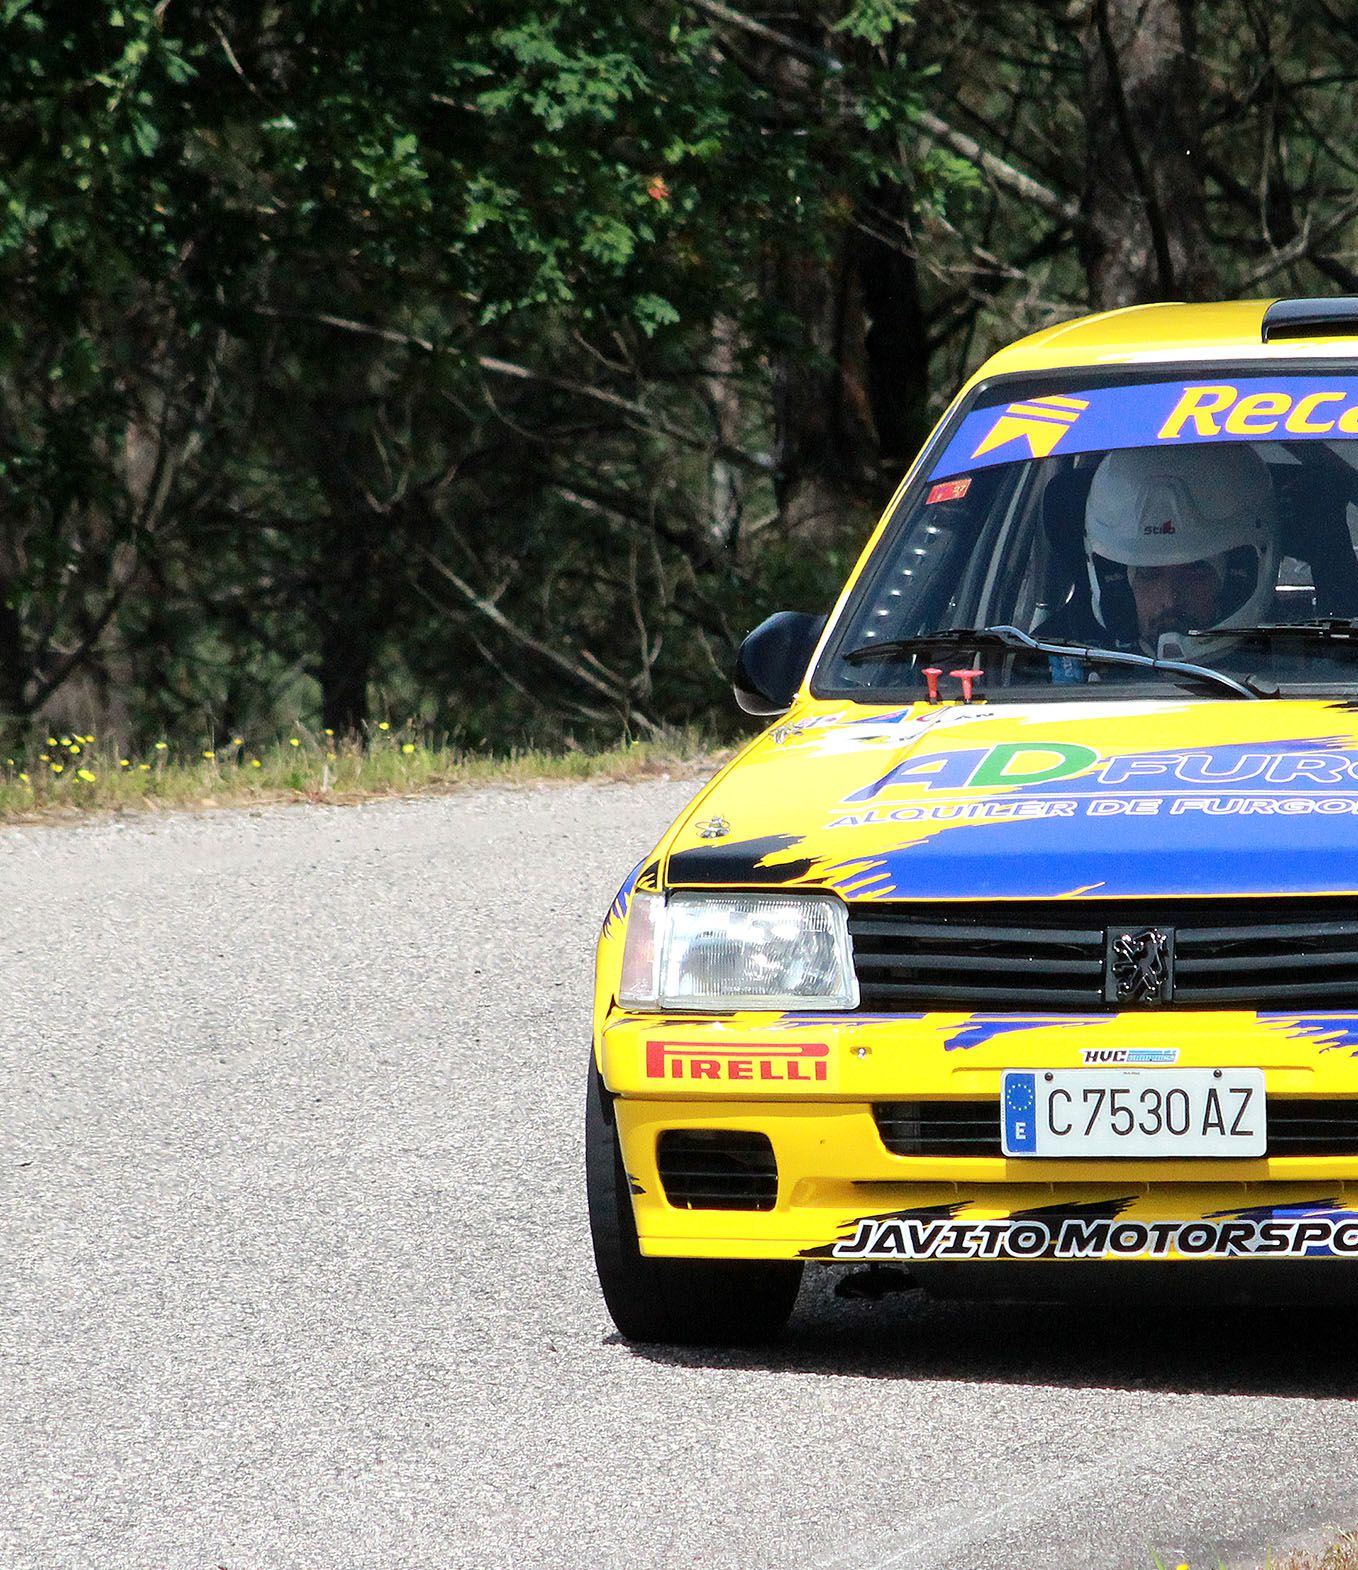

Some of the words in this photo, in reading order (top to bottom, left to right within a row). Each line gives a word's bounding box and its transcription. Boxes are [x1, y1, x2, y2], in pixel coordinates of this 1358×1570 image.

[824, 799, 1076, 829] ALQUILER
[1086, 799, 1163, 816] DE
[646, 1041, 830, 1081] PIRELLI
[1084, 1050, 1127, 1062] HVC
[1048, 1088, 1073, 1136] C
[1082, 1088, 1191, 1137] 7530
[1201, 1087, 1255, 1137] AZ
[1015, 1122, 1027, 1140] E
[834, 1219, 1051, 1260] JAVITO
